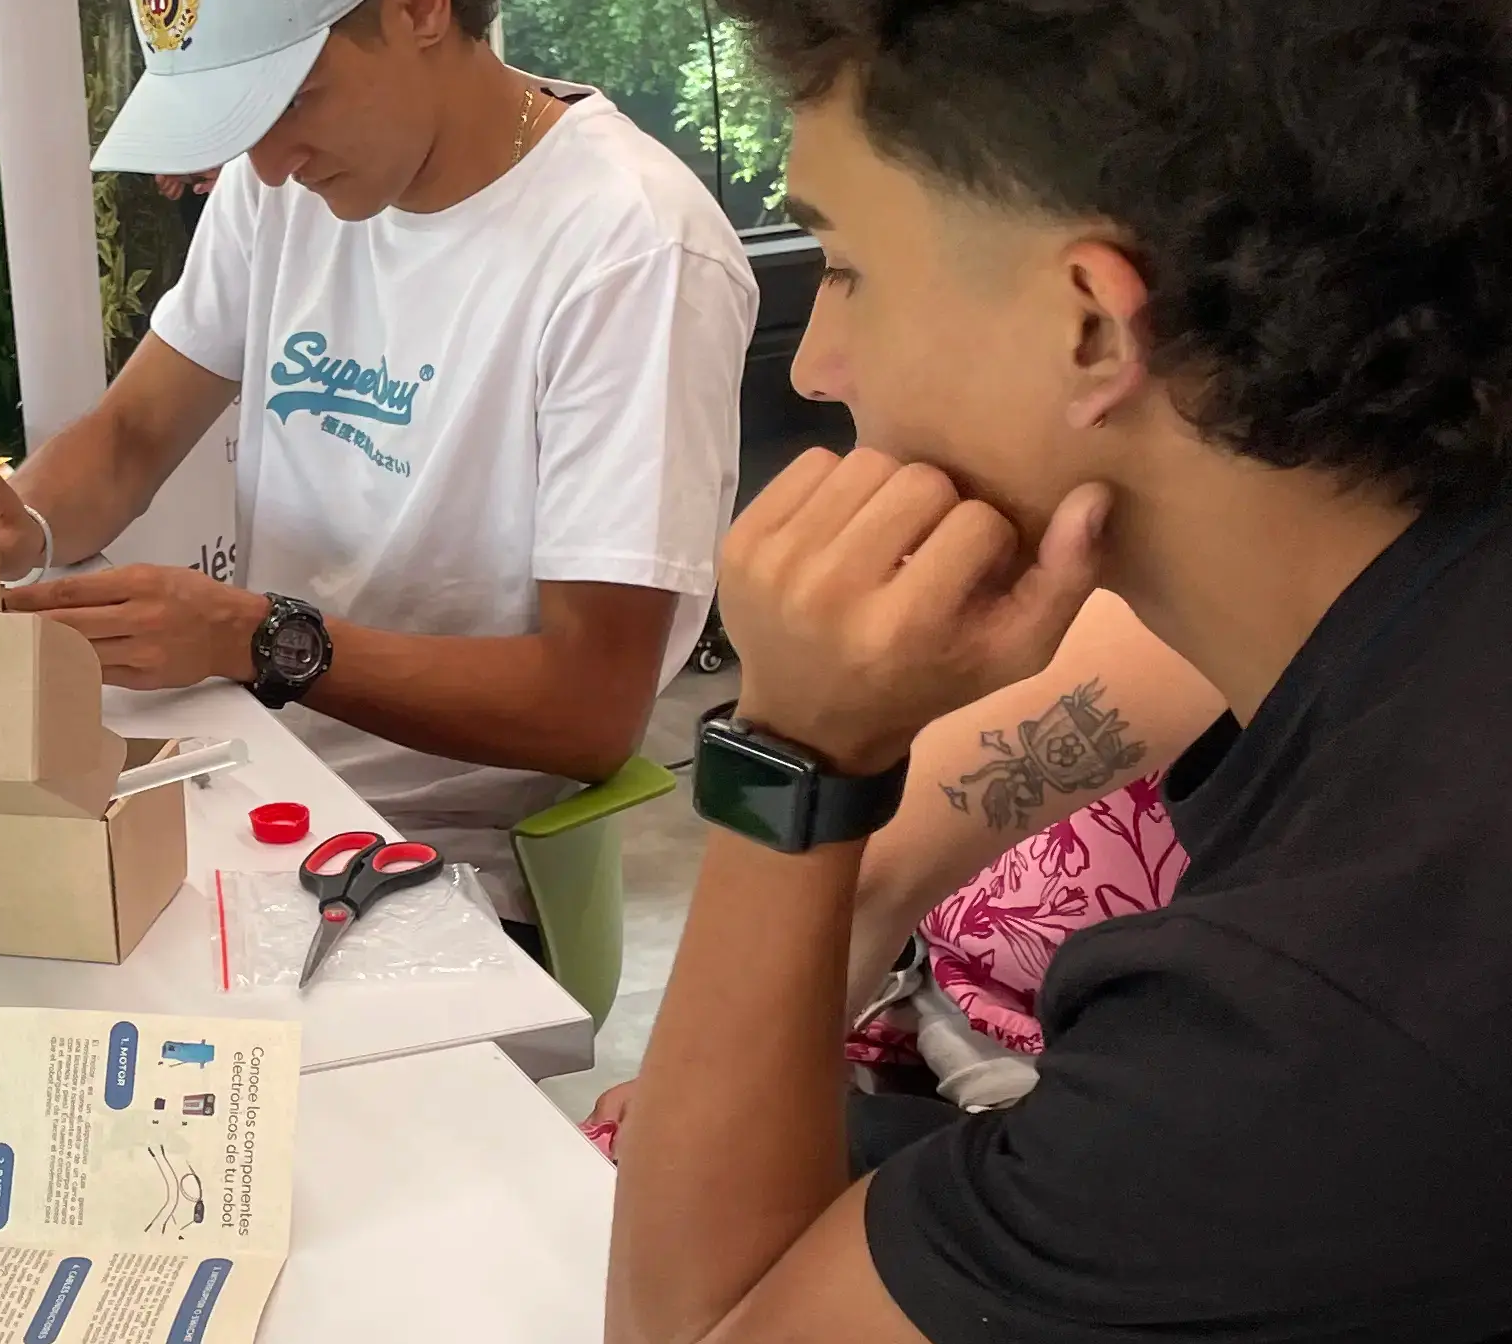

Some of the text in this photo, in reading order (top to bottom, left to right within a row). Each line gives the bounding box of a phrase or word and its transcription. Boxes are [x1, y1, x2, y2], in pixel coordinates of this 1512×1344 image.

[116, 1047, 128, 1086] MOTOR
[221, 1051, 246, 1228] electrónicos de tu robot
[237, 1046, 263, 1236] Conoce los componentes
